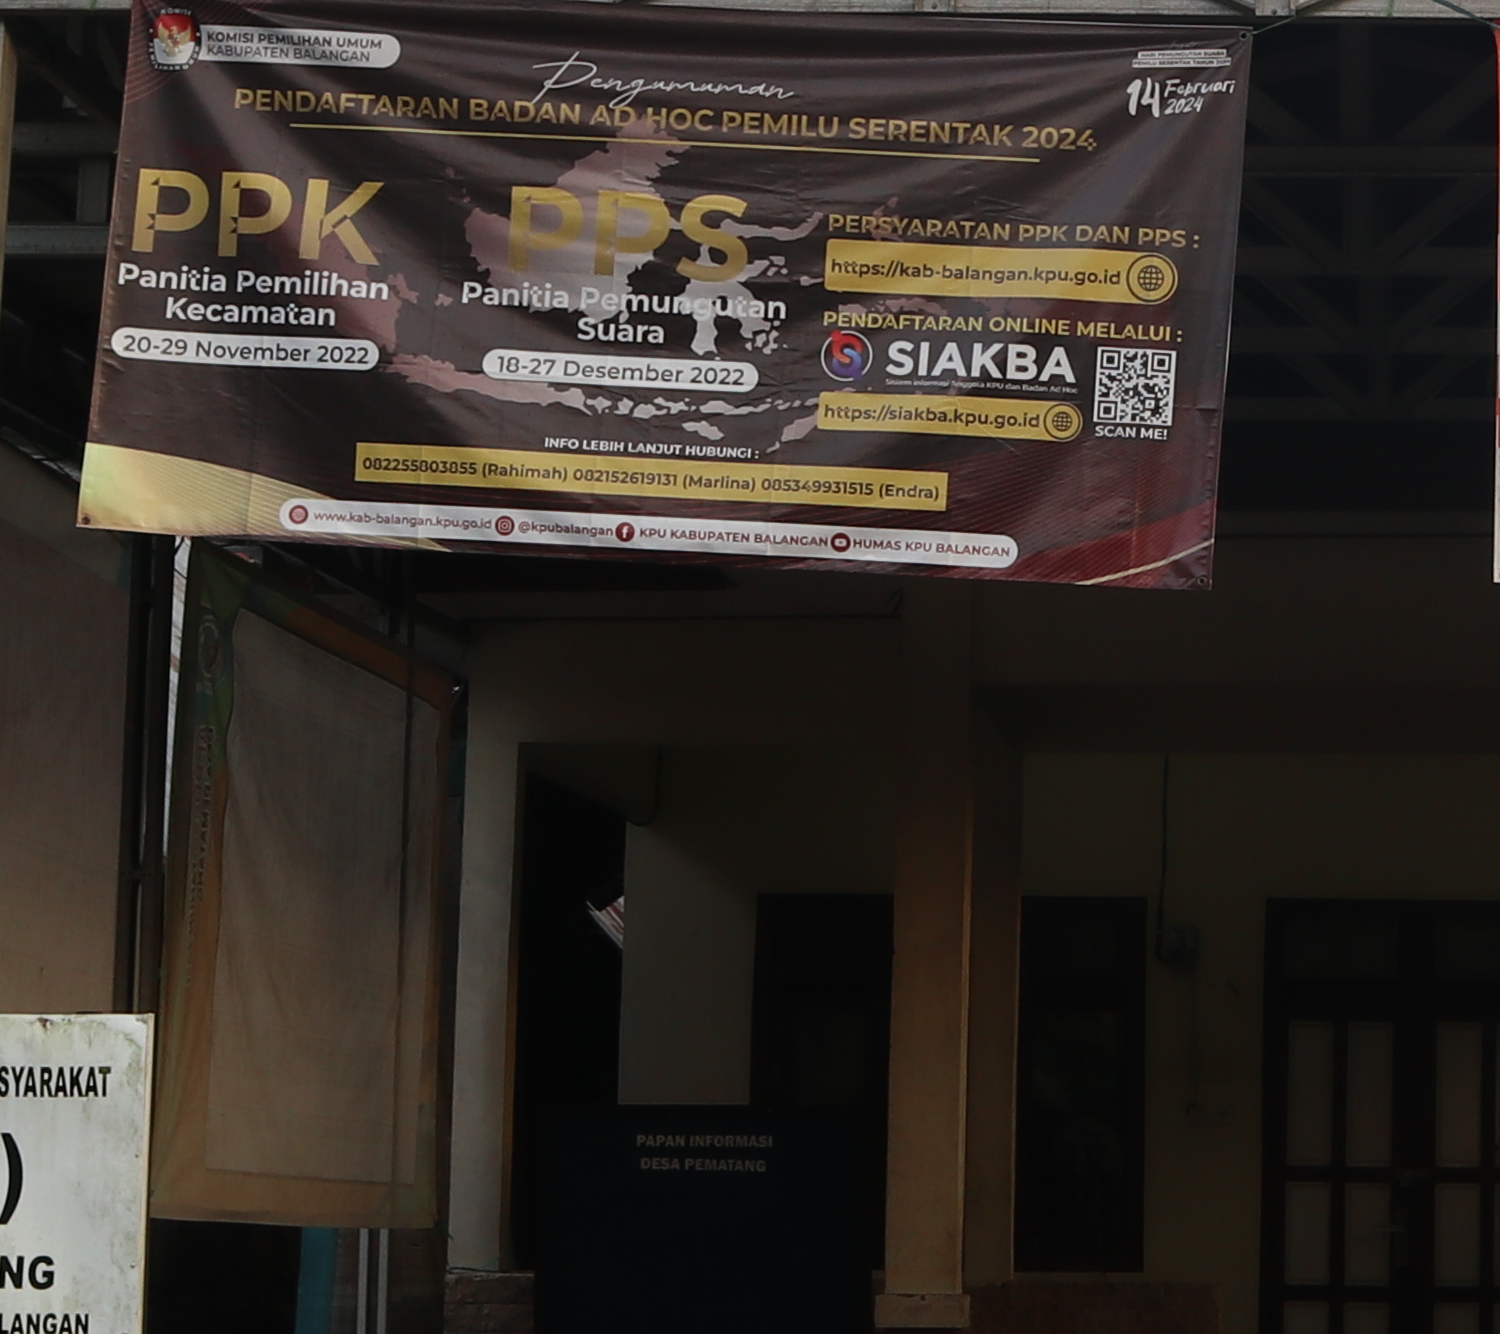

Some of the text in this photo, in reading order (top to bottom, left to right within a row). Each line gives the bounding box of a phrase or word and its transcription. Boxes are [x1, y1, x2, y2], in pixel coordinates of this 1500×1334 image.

[207, 31, 382, 49] KOMISI PEMILIHAN UMUM
[207, 44, 289, 59] KABUPATEN
[294, 47, 370, 62] BALANGAN
[532, 51, 794, 108] Pengumuman
[234, 88, 1098, 152] PENDAFTARAN BADAN AD HOC PEMILU SERENTAK 2024
[132, 167, 385, 266] PPK
[829, 214, 1185, 248] PERSYARATAN PPK DAN PPS
[509, 186, 748, 281] PPS
[118, 263, 389, 301] Panitia Pemilihan
[831, 260, 1121, 286] https://kab-balangan.kpu.go.id
[166, 296, 336, 327] Kecamatan
[461, 281, 787, 322] Panitia Pemungutan
[577, 319, 665, 344] Suara
[823, 311, 1171, 341] PENDAFTARAN ONLINE MELALUI
[123, 334, 370, 364] 20-29 November 2022
[885, 341, 1077, 384] SIAKBA
[496, 355, 744, 386] 18-27 Desember 2022
[824, 405, 1040, 430] https://siakba.kpu.go.id
[481, 462, 568, 483] (Rahimah)
[573, 468, 677, 487] 082152619131
[682, 473, 756, 493] (Marlina)
[878, 482, 939, 501] (Endra)
[313, 509, 614, 539] www.kab-balangan.kpu.go.id @kpubalangan
[636, 1135, 772, 1147] PAPAN INFORMASI
[640, 1158, 766, 1172] DESA PEMATANG
